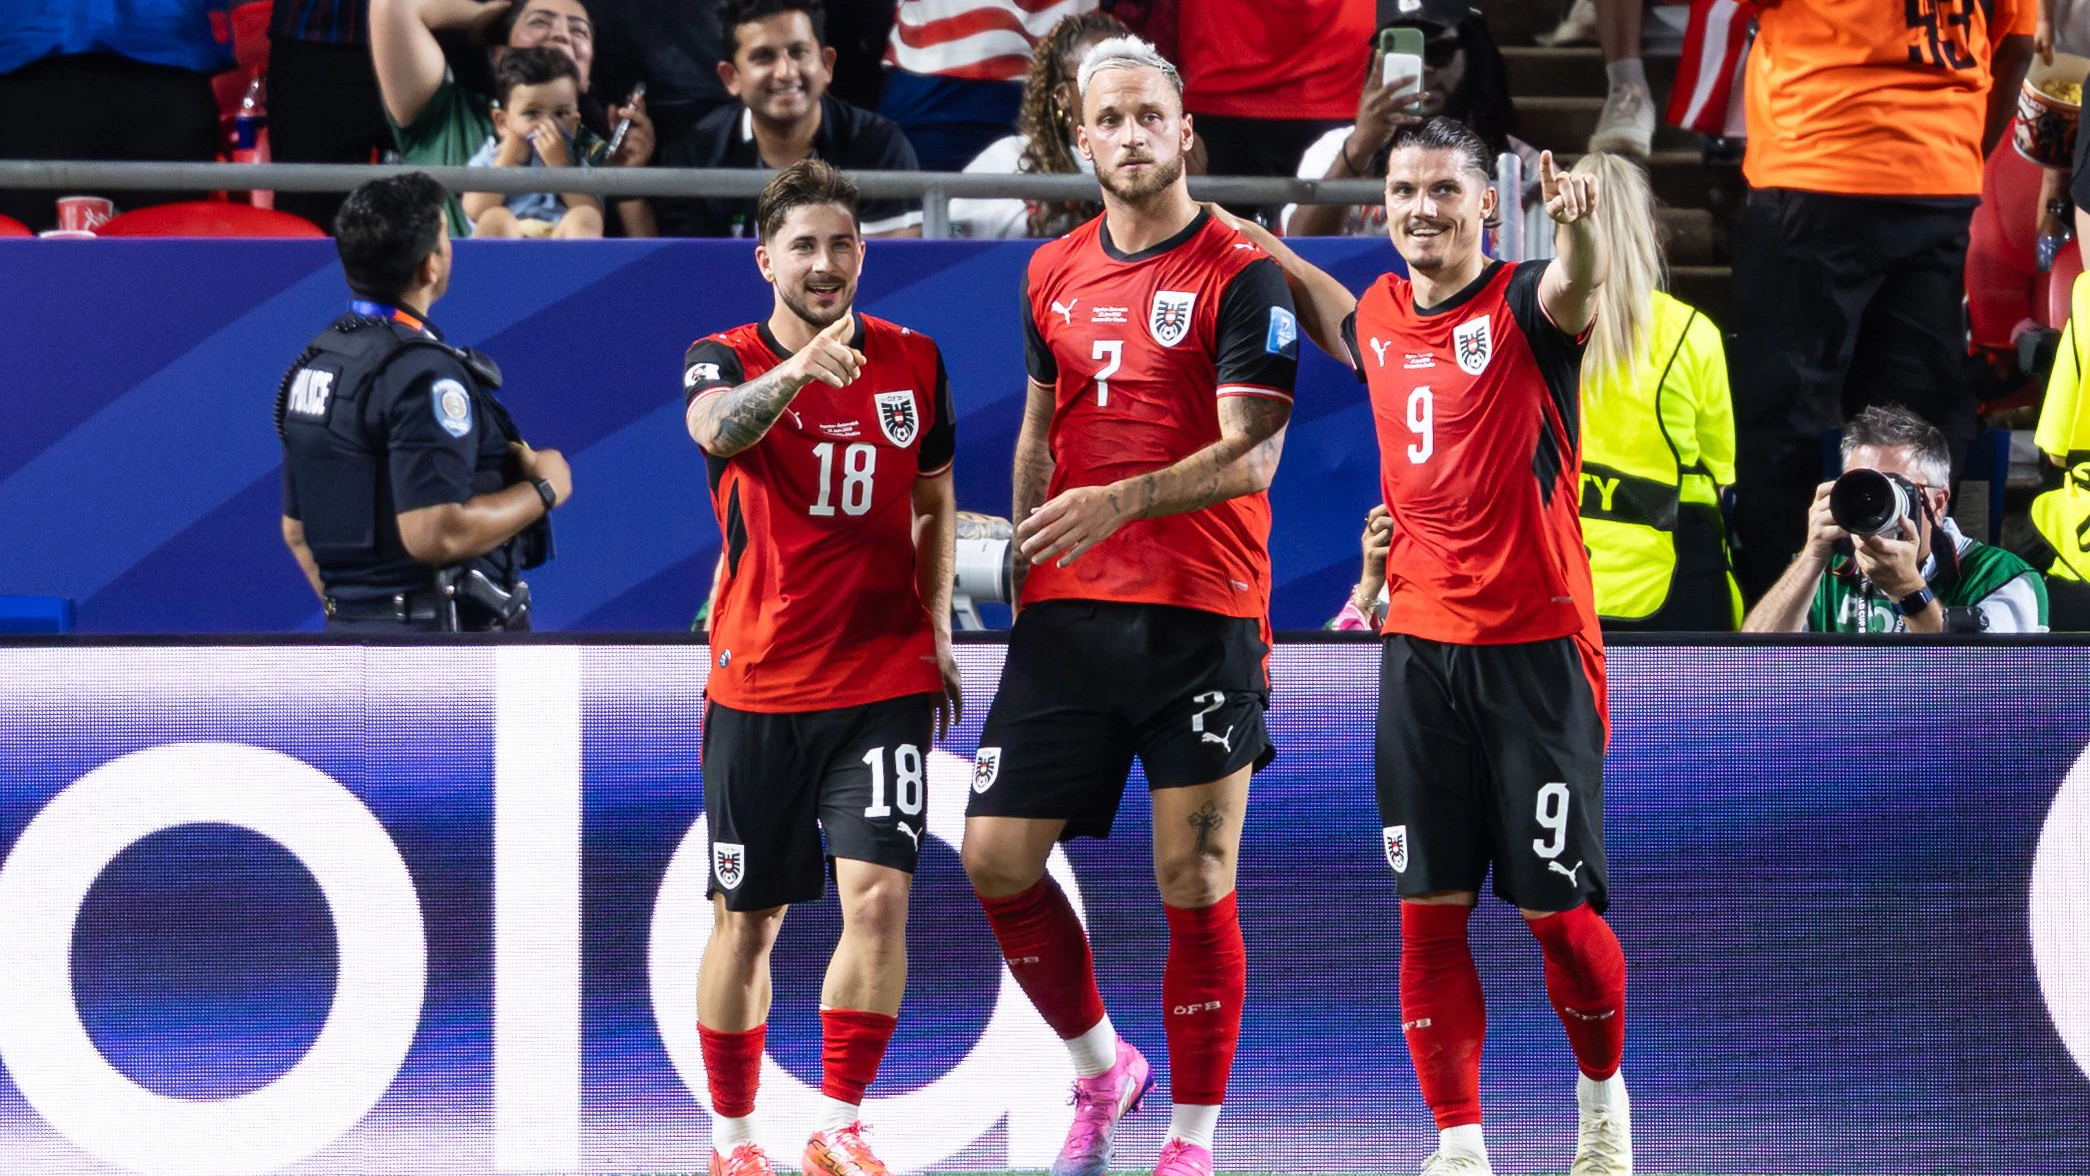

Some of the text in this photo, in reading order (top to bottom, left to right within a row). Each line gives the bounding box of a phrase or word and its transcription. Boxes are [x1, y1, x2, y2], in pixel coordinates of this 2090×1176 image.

[1092, 340, 1124, 407] 7
[1406, 386, 1434, 464] 9
[809, 442, 877, 516] 18
[1192, 691, 1225, 732] 7
[862, 744, 923, 818] 18
[1532, 782, 1570, 858] 9
